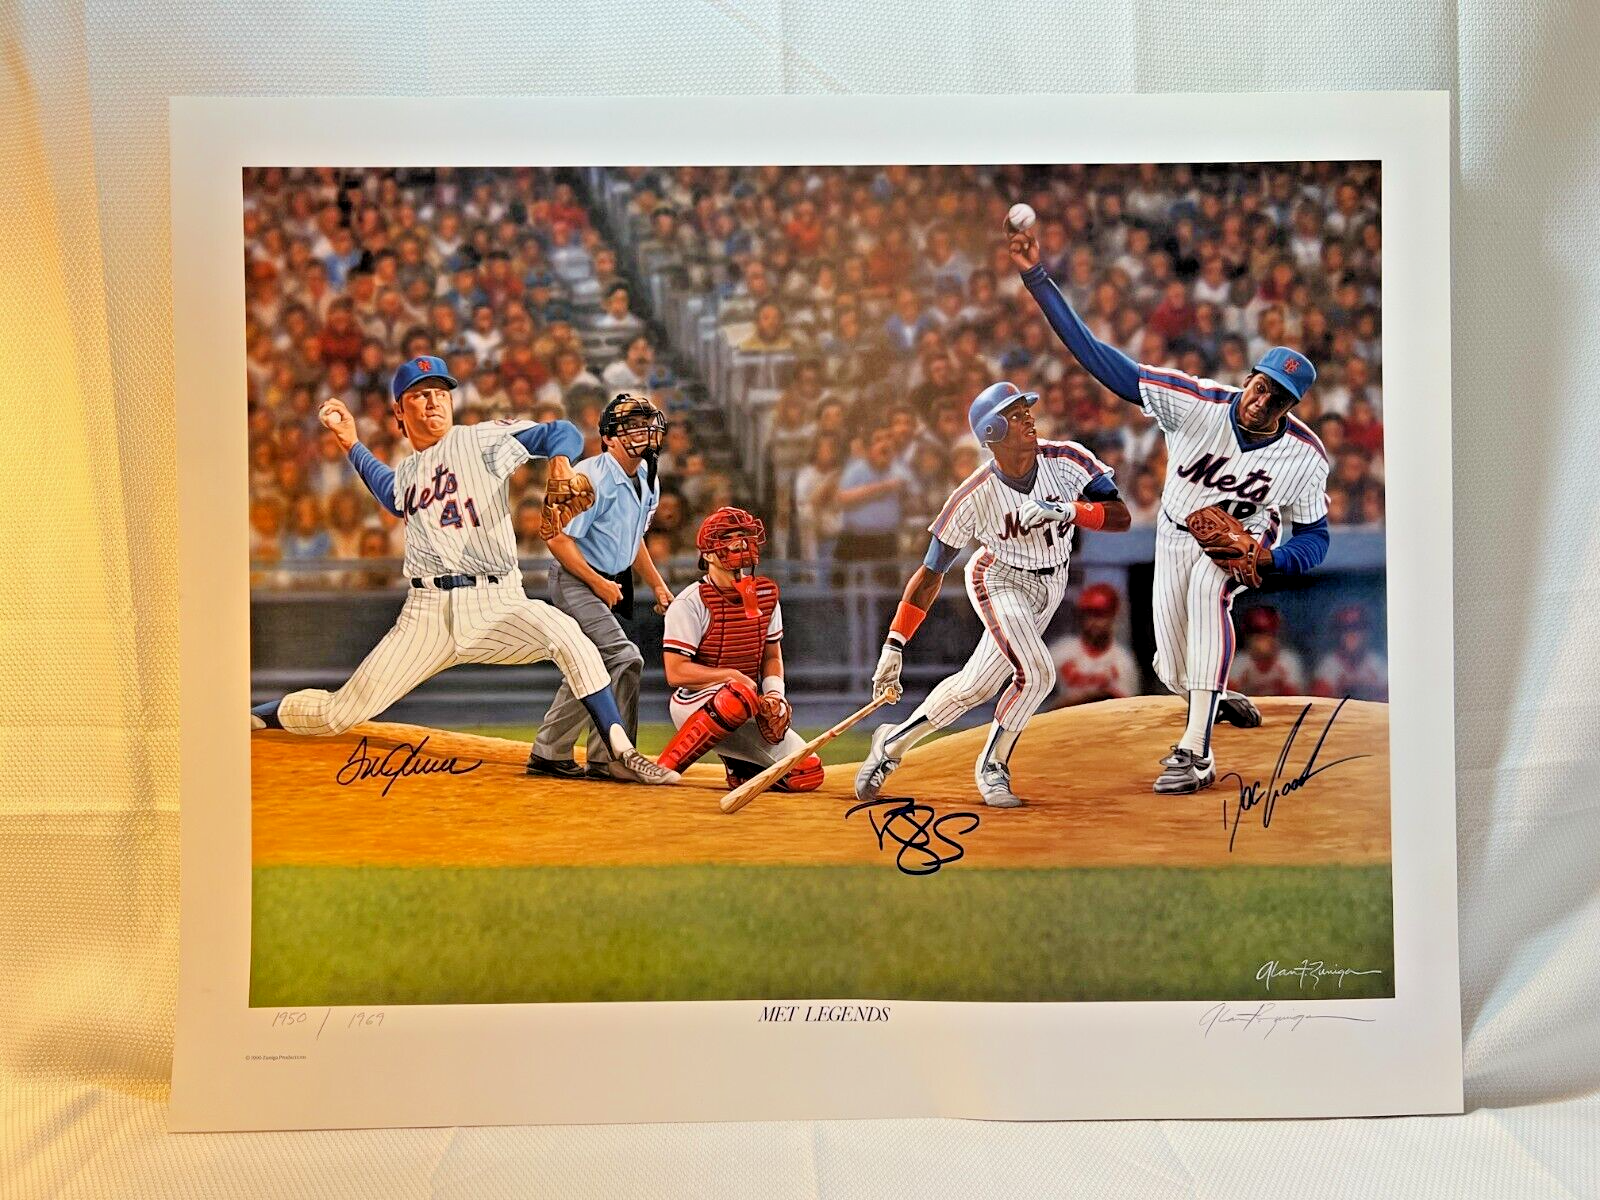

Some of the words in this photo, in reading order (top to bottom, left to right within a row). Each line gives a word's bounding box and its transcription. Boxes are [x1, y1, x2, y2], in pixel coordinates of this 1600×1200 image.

[1177, 453, 1272, 502] Mets
[440, 498, 481, 530] 41
[758, 1005, 800, 1023] MET
[804, 1005, 891, 1023] LEGENDS
